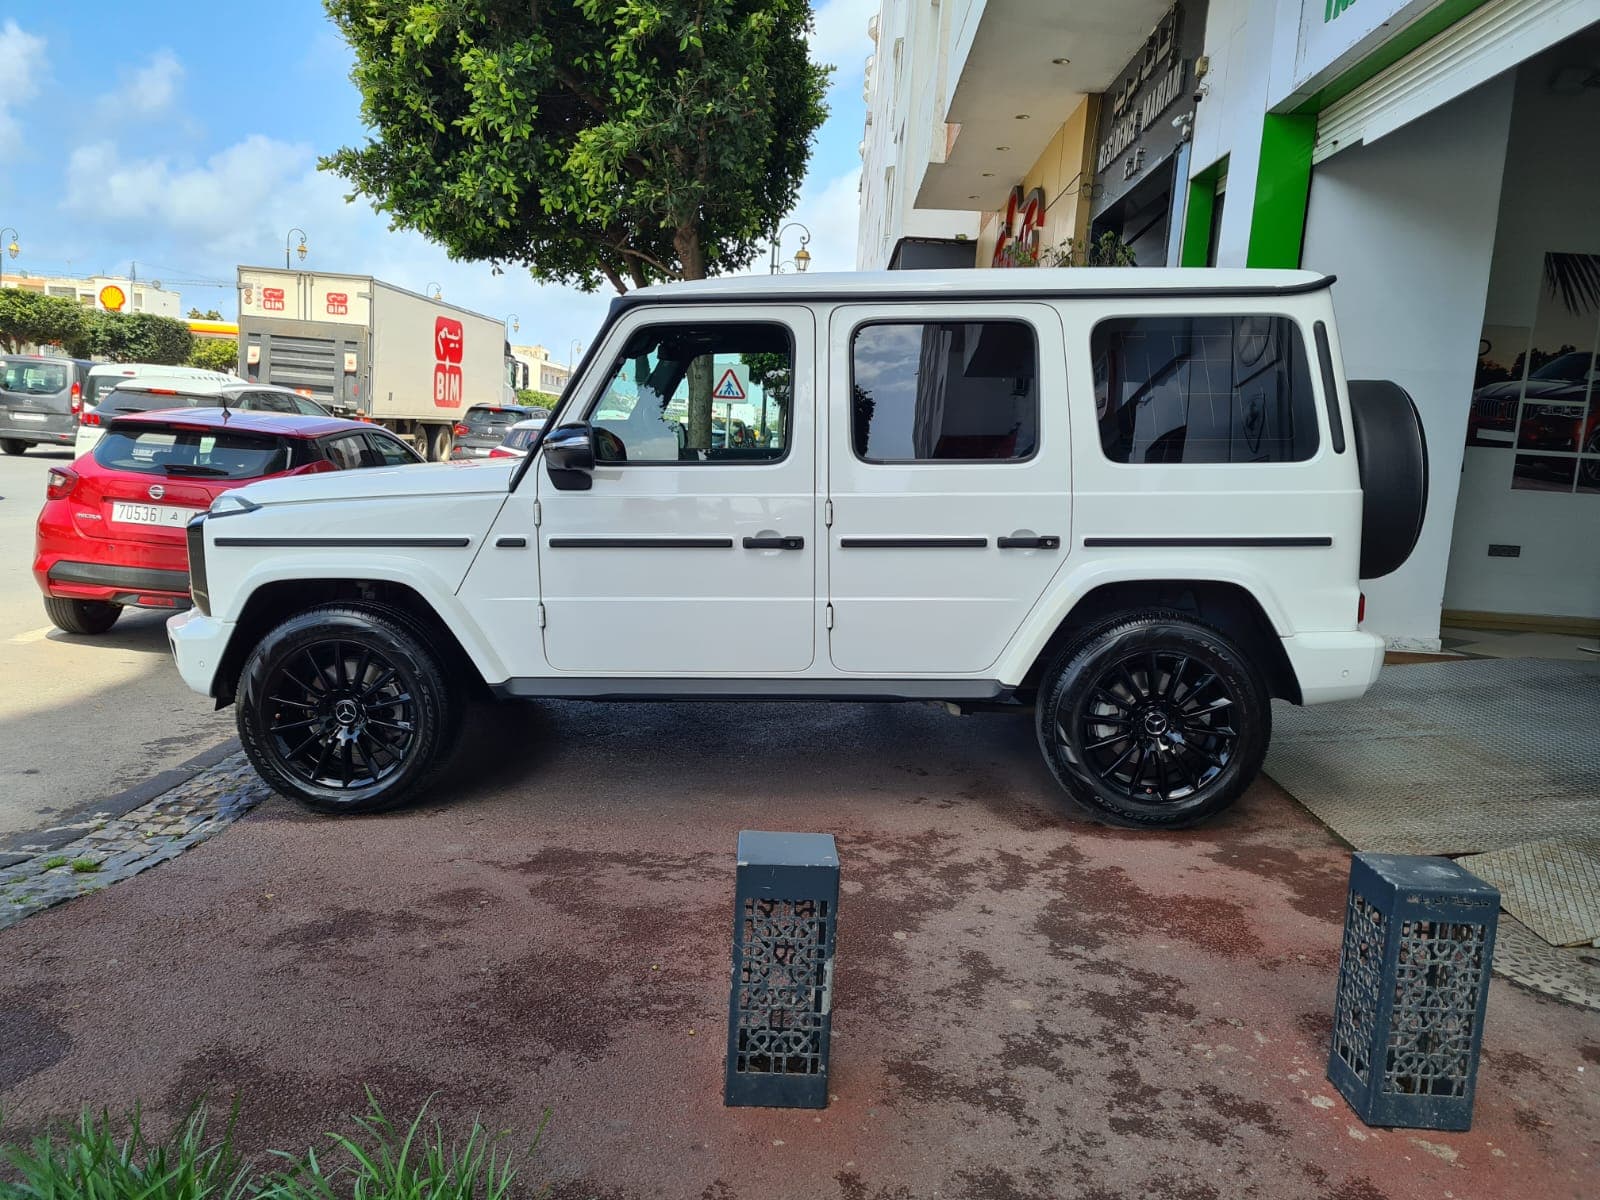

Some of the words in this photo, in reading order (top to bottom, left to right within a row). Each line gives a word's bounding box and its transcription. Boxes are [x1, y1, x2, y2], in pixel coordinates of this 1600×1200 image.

[265, 300, 283, 310] BIM
[328, 304, 346, 314] BIM
[436, 372, 460, 401] BIM
[119, 504, 157, 522] 70536
